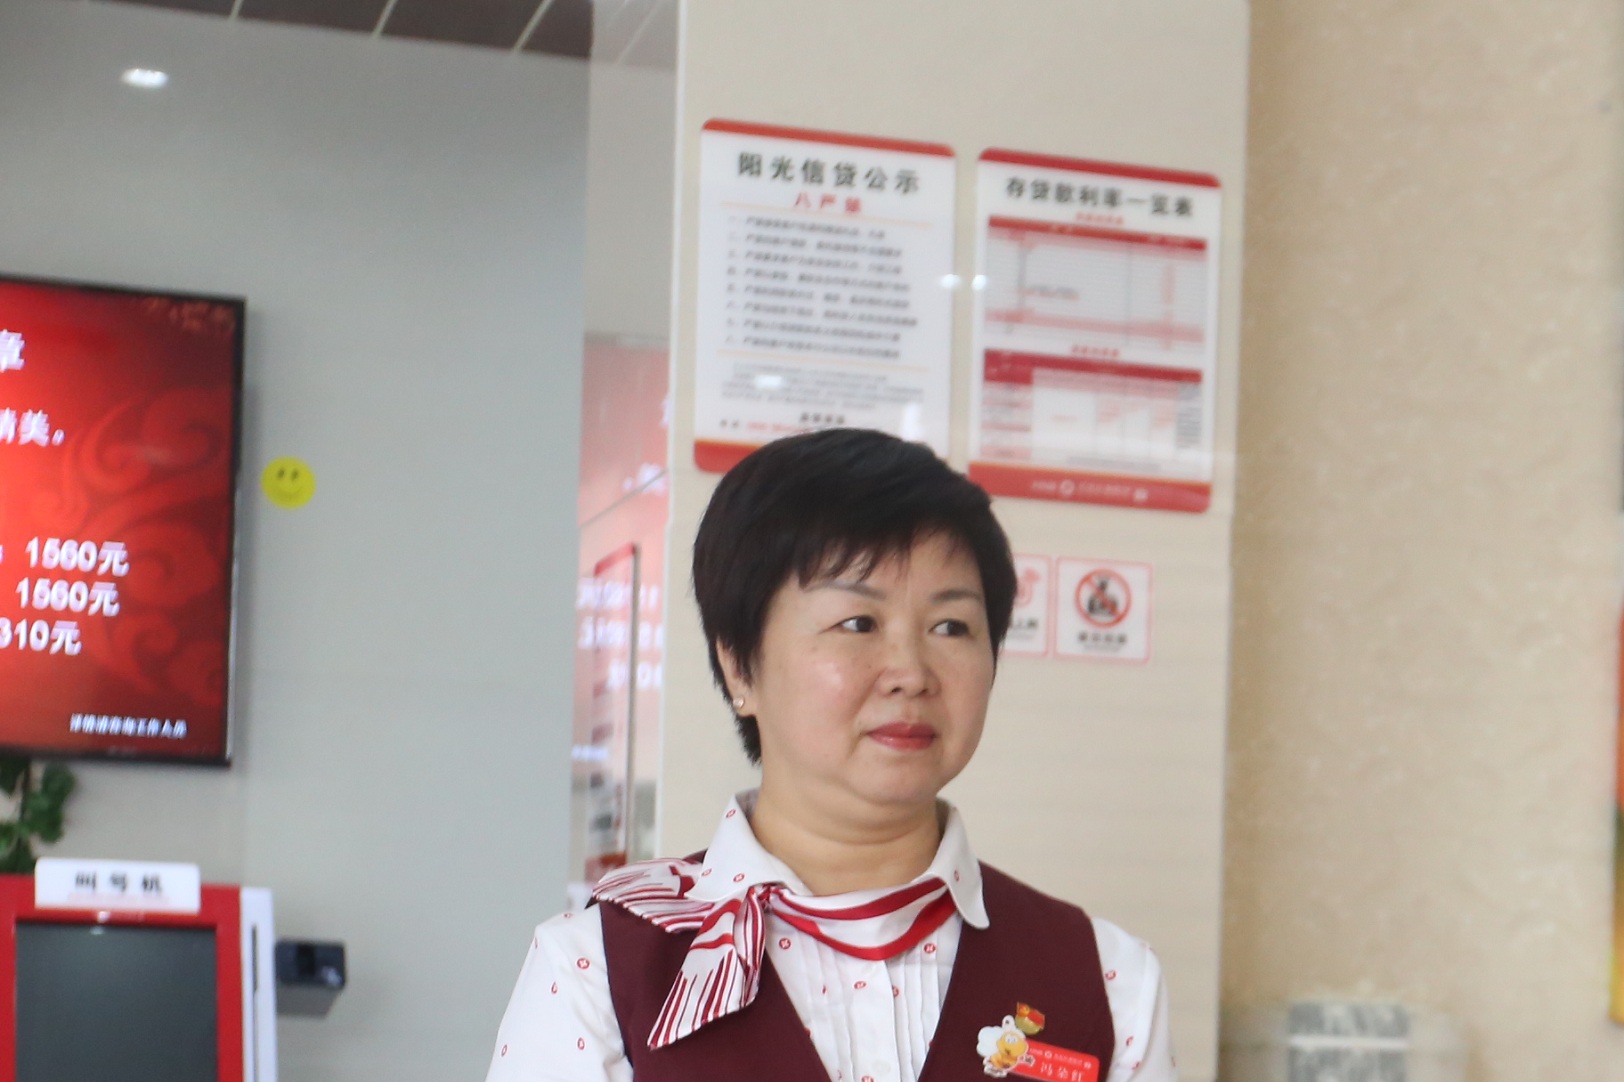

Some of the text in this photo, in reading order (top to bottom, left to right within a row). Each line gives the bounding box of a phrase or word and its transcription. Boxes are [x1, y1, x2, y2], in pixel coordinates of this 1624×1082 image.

[737, 152, 921, 194] 阳光信贷公示
[1005, 176, 1195, 218] 存贷款利率一览表
[75, 870, 163, 893] 叫号机
